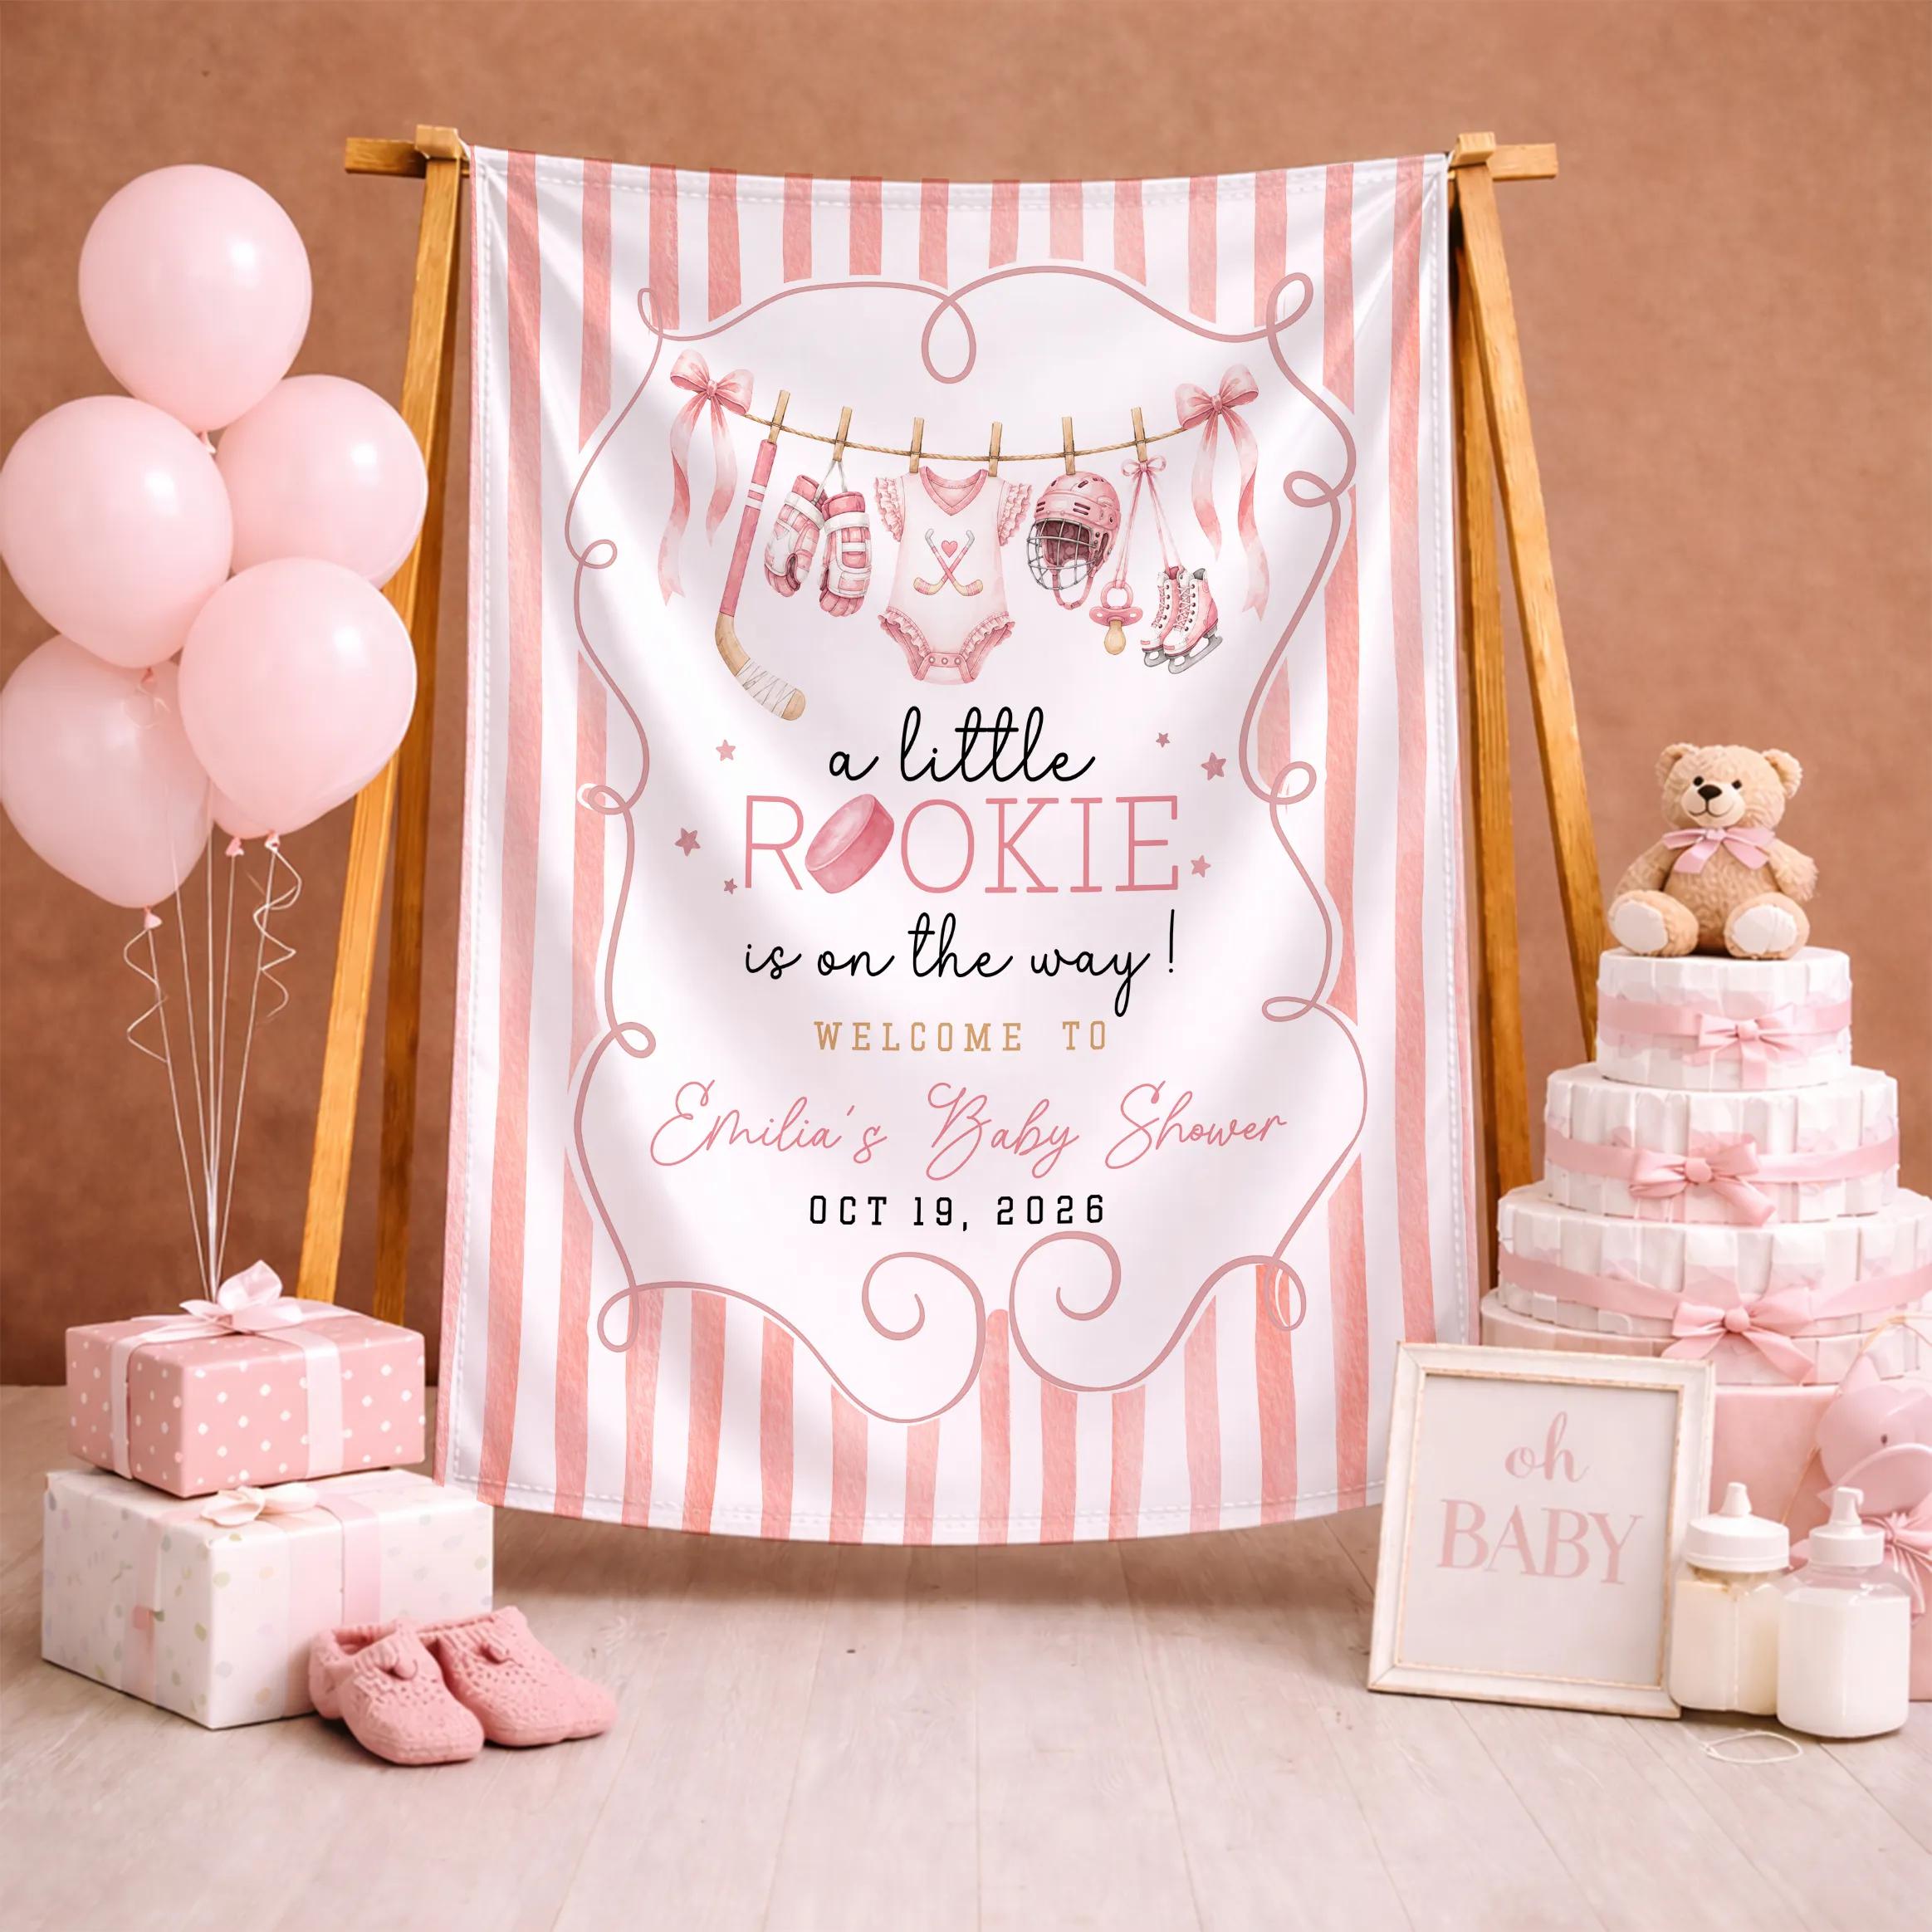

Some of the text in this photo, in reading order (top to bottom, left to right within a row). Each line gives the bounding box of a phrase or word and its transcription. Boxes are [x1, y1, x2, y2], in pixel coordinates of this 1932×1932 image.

[829, 706, 1096, 782] a little
[746, 944, 803, 980] is
[818, 951, 896, 977] on
[907, 912, 1014, 978] the
[814, 1020, 1106, 1052] WELCOME TO
[650, 1079, 1288, 1181] Emilia's Baby Shower
[810, 1195, 1103, 1232] OCT 19, 2026
[1504, 1411, 1590, 1483] oh
[1437, 1499, 1643, 1585] BABY
